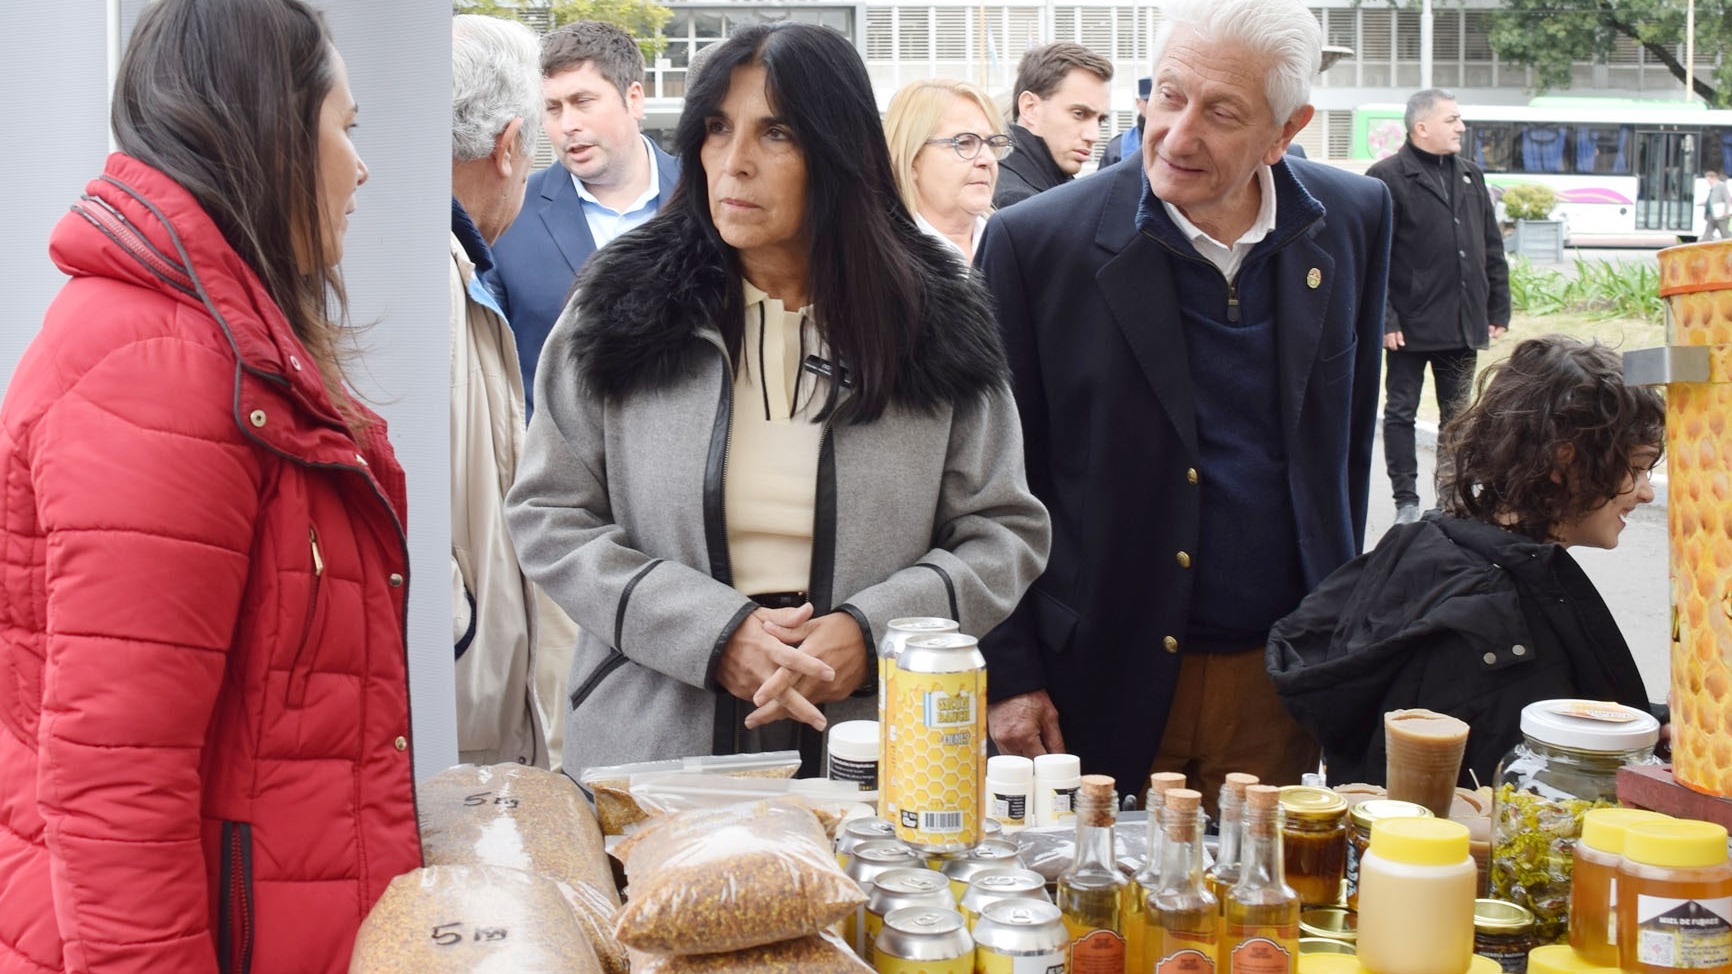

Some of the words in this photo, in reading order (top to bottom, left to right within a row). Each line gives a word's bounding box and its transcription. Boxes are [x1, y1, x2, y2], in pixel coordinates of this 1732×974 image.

[463, 791, 492, 807] 5
[1658, 916, 1679, 925] MIEL
[1679, 917, 1691, 925] DE
[431, 921, 463, 946] 5
